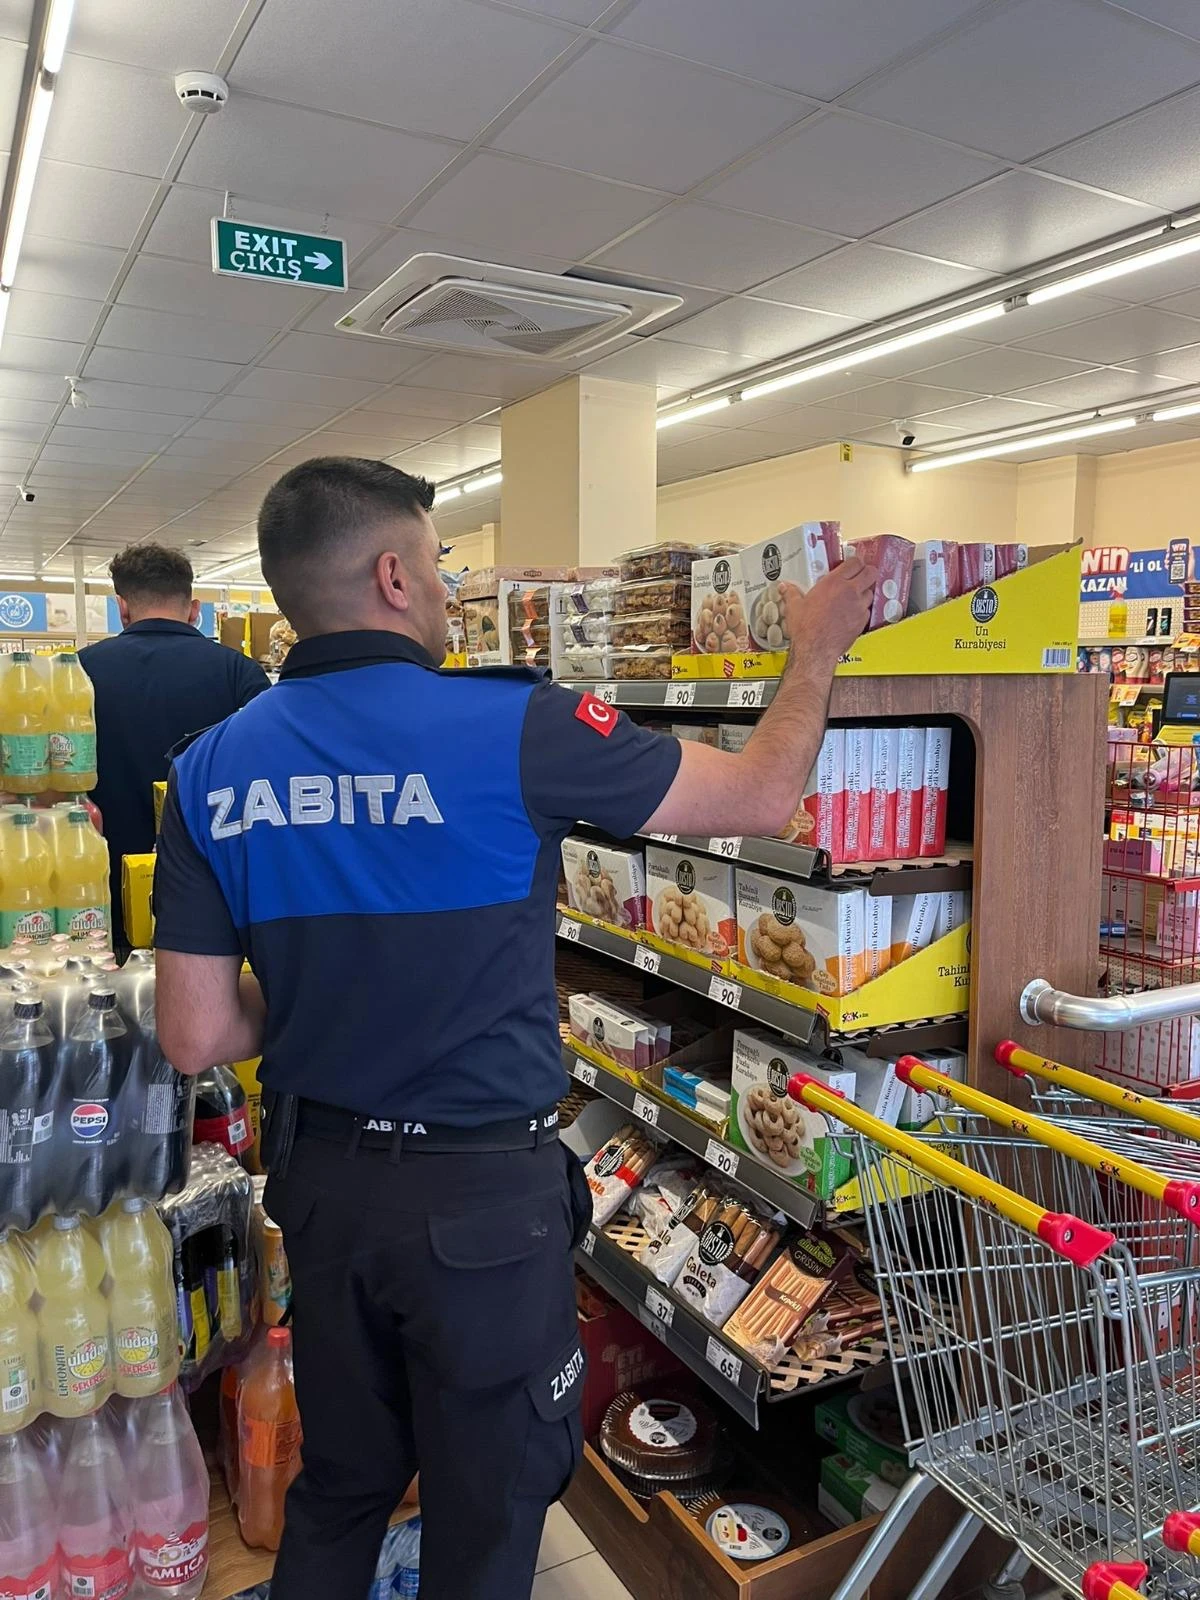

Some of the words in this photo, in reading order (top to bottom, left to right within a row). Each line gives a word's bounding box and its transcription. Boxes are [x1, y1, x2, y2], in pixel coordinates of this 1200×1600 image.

[234, 230, 298, 257] EXIT
[230, 250, 302, 281] ÇIKIŞ
[1147, 560, 1162, 572] OL
[1080, 576, 1127, 593] KAZAN
[975, 625, 989, 637] Un
[954, 638, 1007, 652] Kurabiyesi
[603, 690, 613, 704] 95
[676, 690, 690, 706] 90
[741, 690, 756, 706] 90
[207, 773, 445, 841] ZABITA
[720, 840, 735, 856] 90
[738, 899, 763, 912] Kurabiye
[946, 892, 954, 932] Kurabiye
[871, 898, 879, 938] Kurabiye
[914, 895, 929, 934] Kurabiye
[567, 926, 577, 940] 90
[643, 956, 655, 971] 90
[871, 941, 879, 977] Susamlı
[938, 963, 970, 977] Tahinl
[721, 988, 735, 1005] 90
[582, 1069, 592, 1084] 90
[735, 1063, 758, 1082] Kurabiye
[72, 1116, 107, 1125] PEPSI
[642, 1106, 654, 1122] 90
[717, 1154, 731, 1173] 90
[702, 1230, 728, 1259] BISTO
[686, 1255, 718, 1289] Galeta
[656, 1302, 668, 1320] 37
[778, 1294, 802, 1313] Kepekli
[550, 1347, 584, 1402] ZABITA
[720, 1358, 734, 1378] 65
